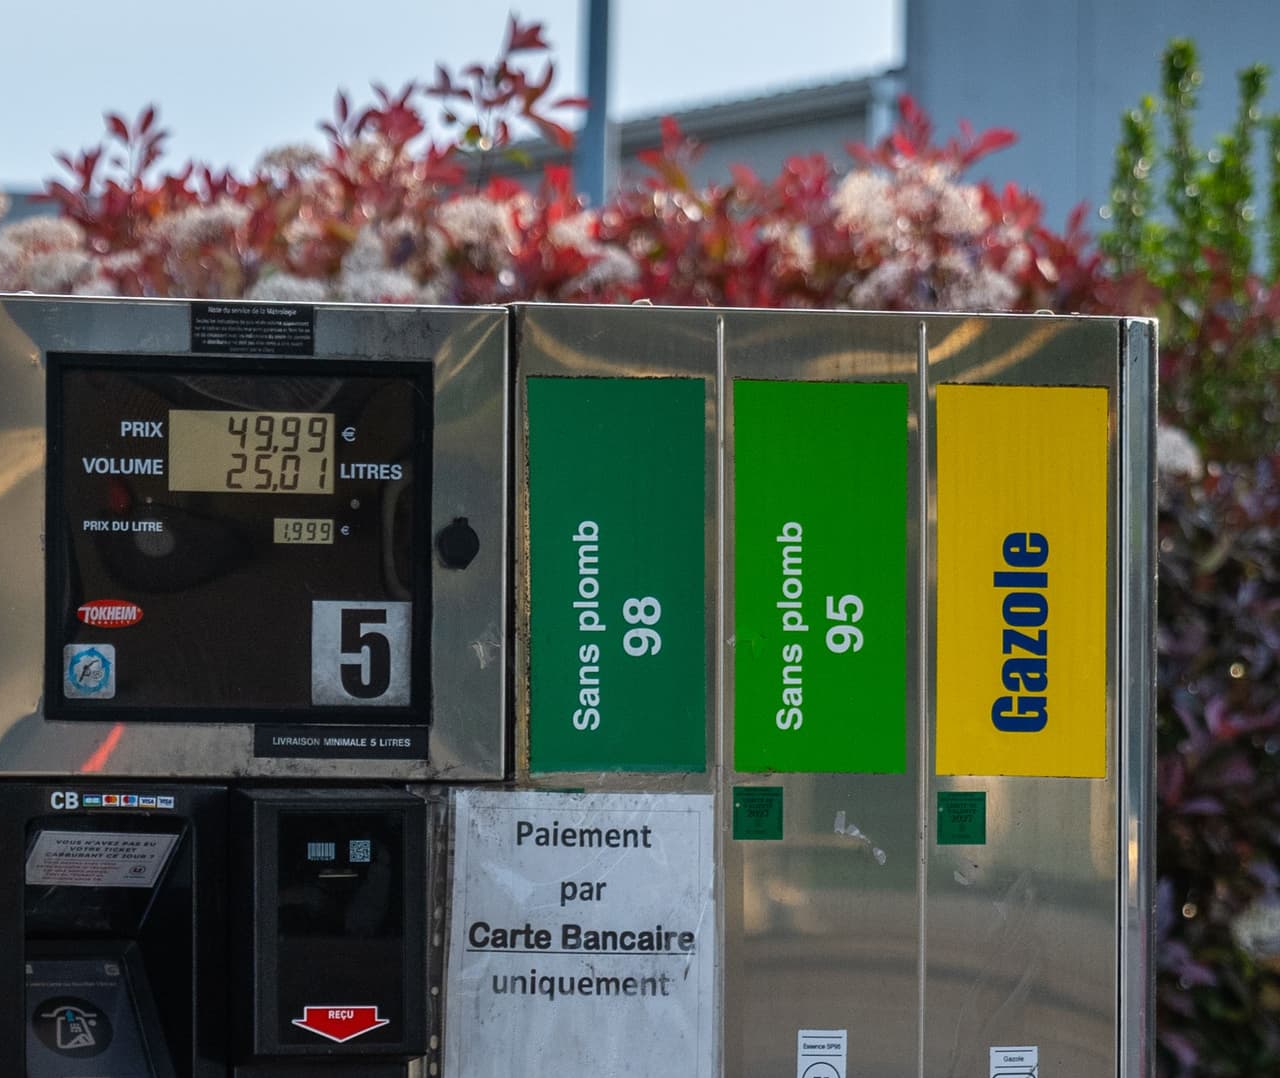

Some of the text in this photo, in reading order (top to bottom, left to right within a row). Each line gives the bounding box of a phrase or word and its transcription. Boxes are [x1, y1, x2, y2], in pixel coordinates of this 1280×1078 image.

[120, 416, 356, 453] PRIX 49,99 €
[82, 453, 403, 491] VOLUME 25,01 LITRES
[83, 520, 350, 541] PRIX DU LITRE 1,999 €
[78, 606, 137, 623] TOKHEIM
[572, 521, 607, 731] Sans plomb
[623, 596, 662, 656] 98
[777, 521, 809, 731] Sans plomb
[826, 594, 864, 653] 95
[991, 532, 1049, 733] Gazole
[340, 608, 391, 700] 5
[272, 737, 411, 748] LIVRAISON MINIMALE 5 LITRES
[50, 791, 79, 810] CB
[516, 820, 652, 849] Paiement
[560, 880, 607, 907] par
[468, 922, 696, 952] Carte Bancaire
[492, 969, 670, 1000] uniquement
[328, 1010, 355, 1020] REÇU
